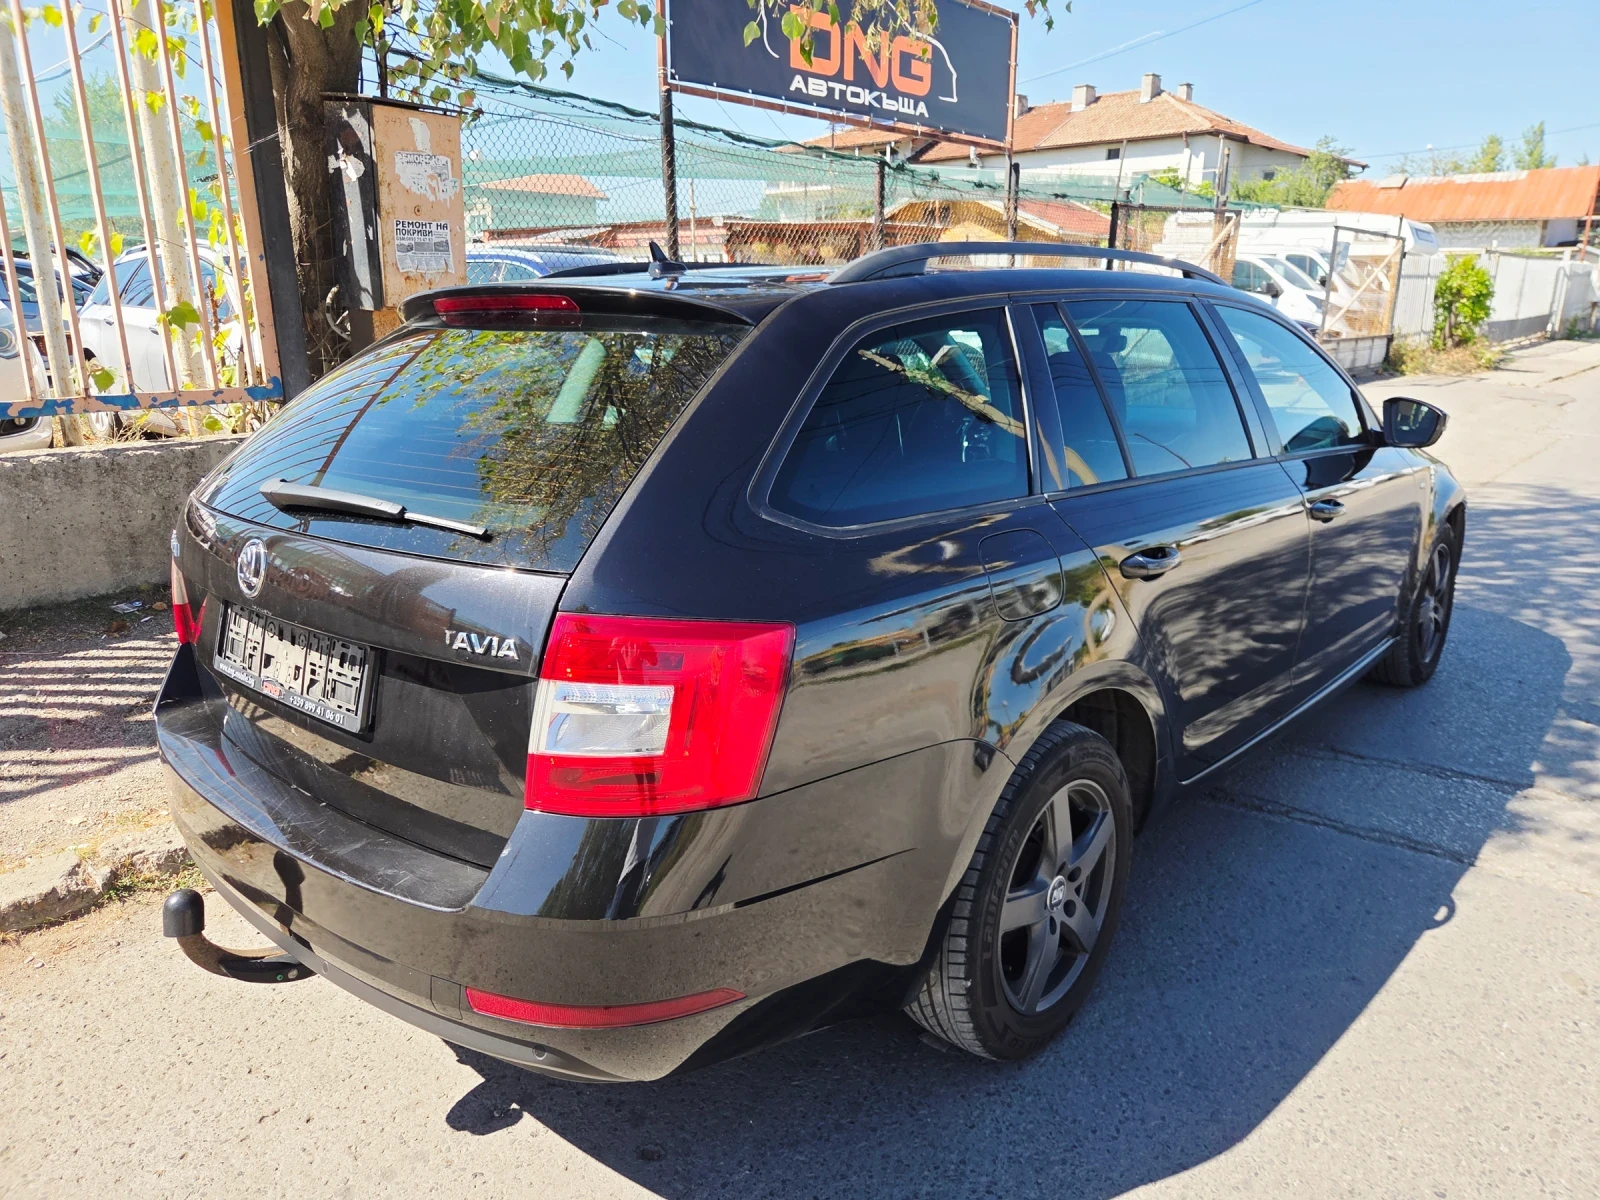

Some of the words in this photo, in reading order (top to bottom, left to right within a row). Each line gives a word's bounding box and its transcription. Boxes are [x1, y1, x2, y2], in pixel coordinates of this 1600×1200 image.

[790, 4, 932, 97] DNG
[789, 74, 929, 118] АВТОКЪЩА
[395, 220, 433, 230] РЕМОНТ
[436, 222, 449, 231] НА
[395, 228, 434, 238] ПОКРИВИ
[304, 701, 316, 713] 899
[316, 705, 324, 717] 41
[325, 709, 334, 721] 06
[335, 712, 344, 724] 01
